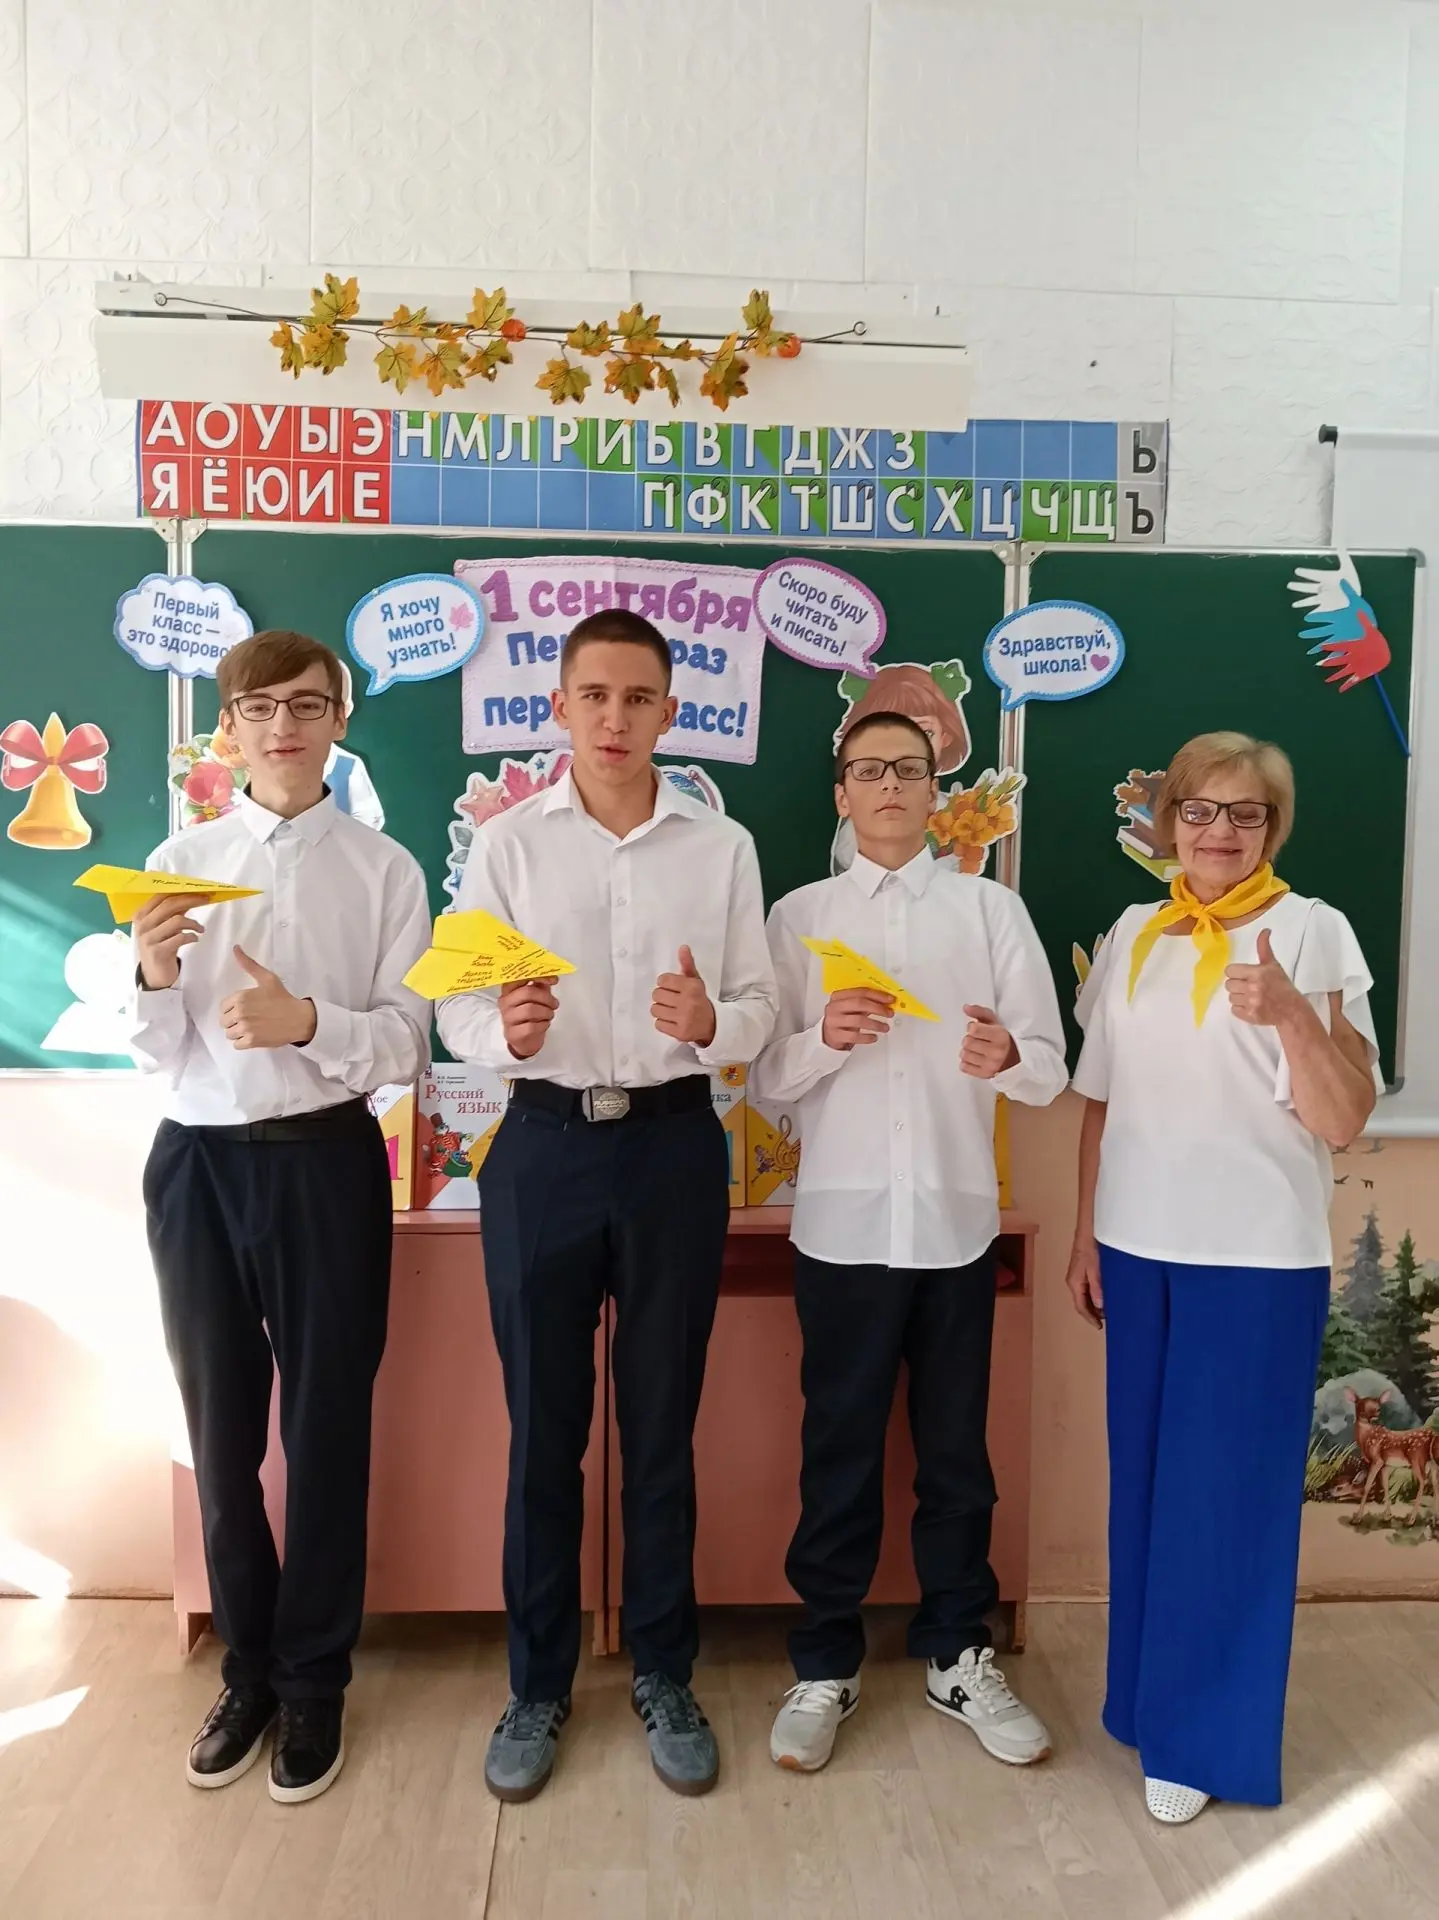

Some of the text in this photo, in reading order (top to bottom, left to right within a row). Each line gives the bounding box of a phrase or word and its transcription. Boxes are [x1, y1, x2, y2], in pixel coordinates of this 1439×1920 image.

[154, 592, 220, 620] Первый
[380, 596, 440, 622] Я хочу
[480, 569, 752, 634] 1 сентября
[778, 571, 869, 624] Скоро буду
[152, 614, 203, 635] класс
[785, 598, 838, 631] читать
[127, 629, 233, 659] это здорово
[388, 618, 444, 642] много
[770, 613, 847, 656] и писать!
[999, 629, 1111, 658] Здравствуй,
[387, 633, 457, 668] узнать!
[668, 638, 728, 675] раз
[1024, 654, 1087, 676] школа!
[484, 694, 552, 732] пер
[425, 1084, 485, 1102] Русский
